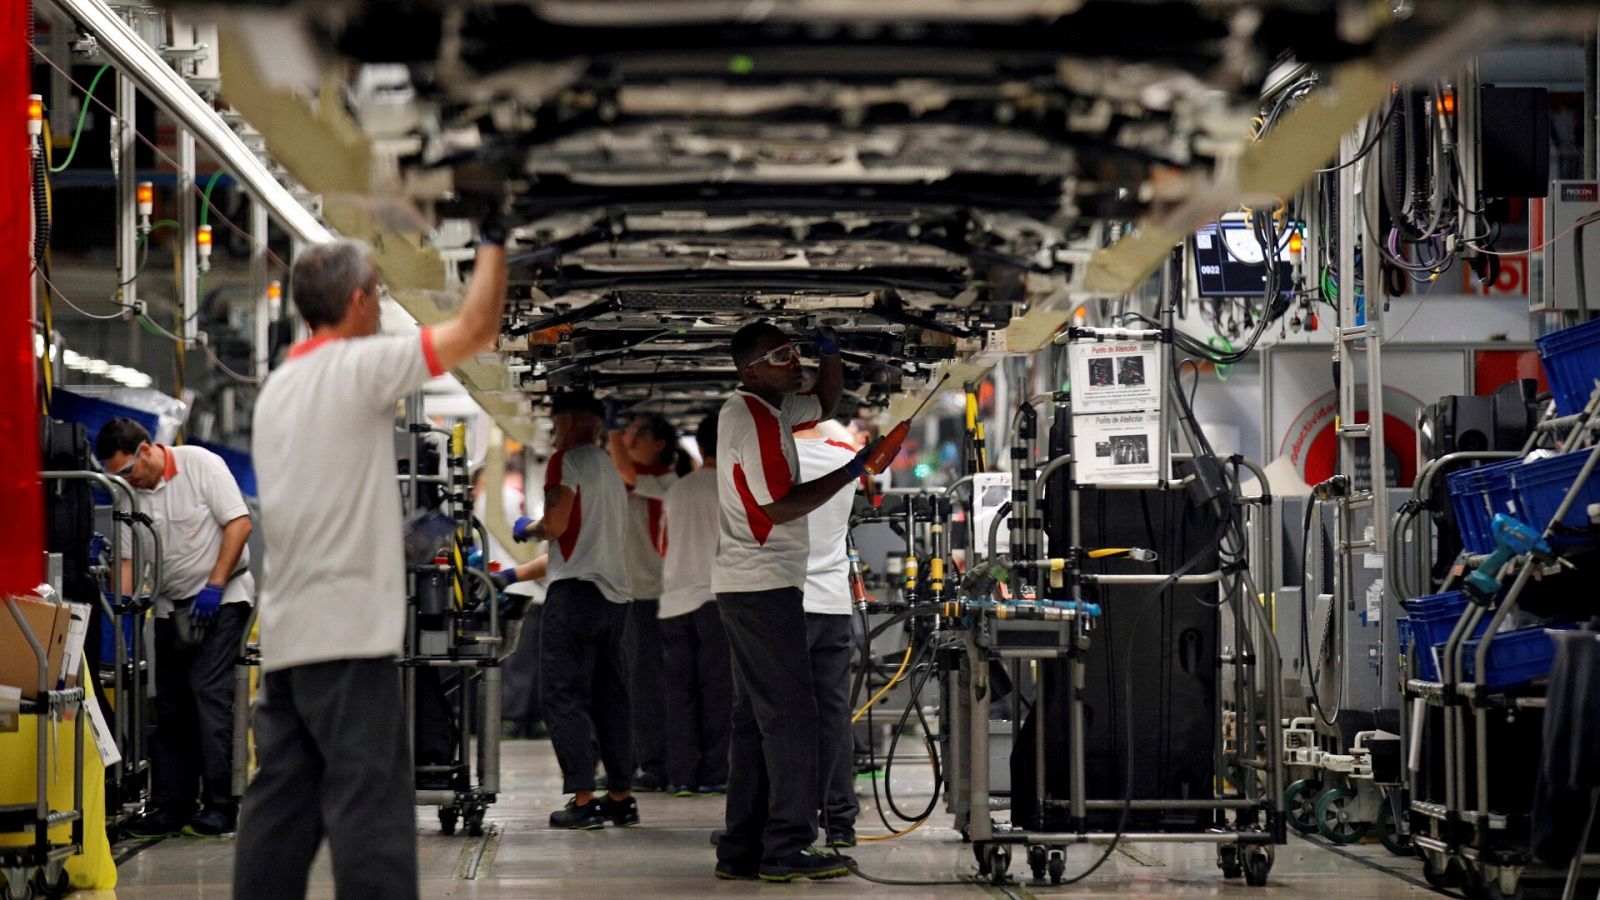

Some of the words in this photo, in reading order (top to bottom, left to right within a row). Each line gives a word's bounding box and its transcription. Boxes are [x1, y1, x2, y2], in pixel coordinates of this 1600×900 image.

[1202, 265, 1220, 275] 0922
[1092, 346, 1106, 354] Punto
[1115, 344, 1137, 353] Atención
[1096, 416, 1111, 424] Punto
[1112, 416, 1119, 424] de
[1120, 415, 1143, 423] Atención
